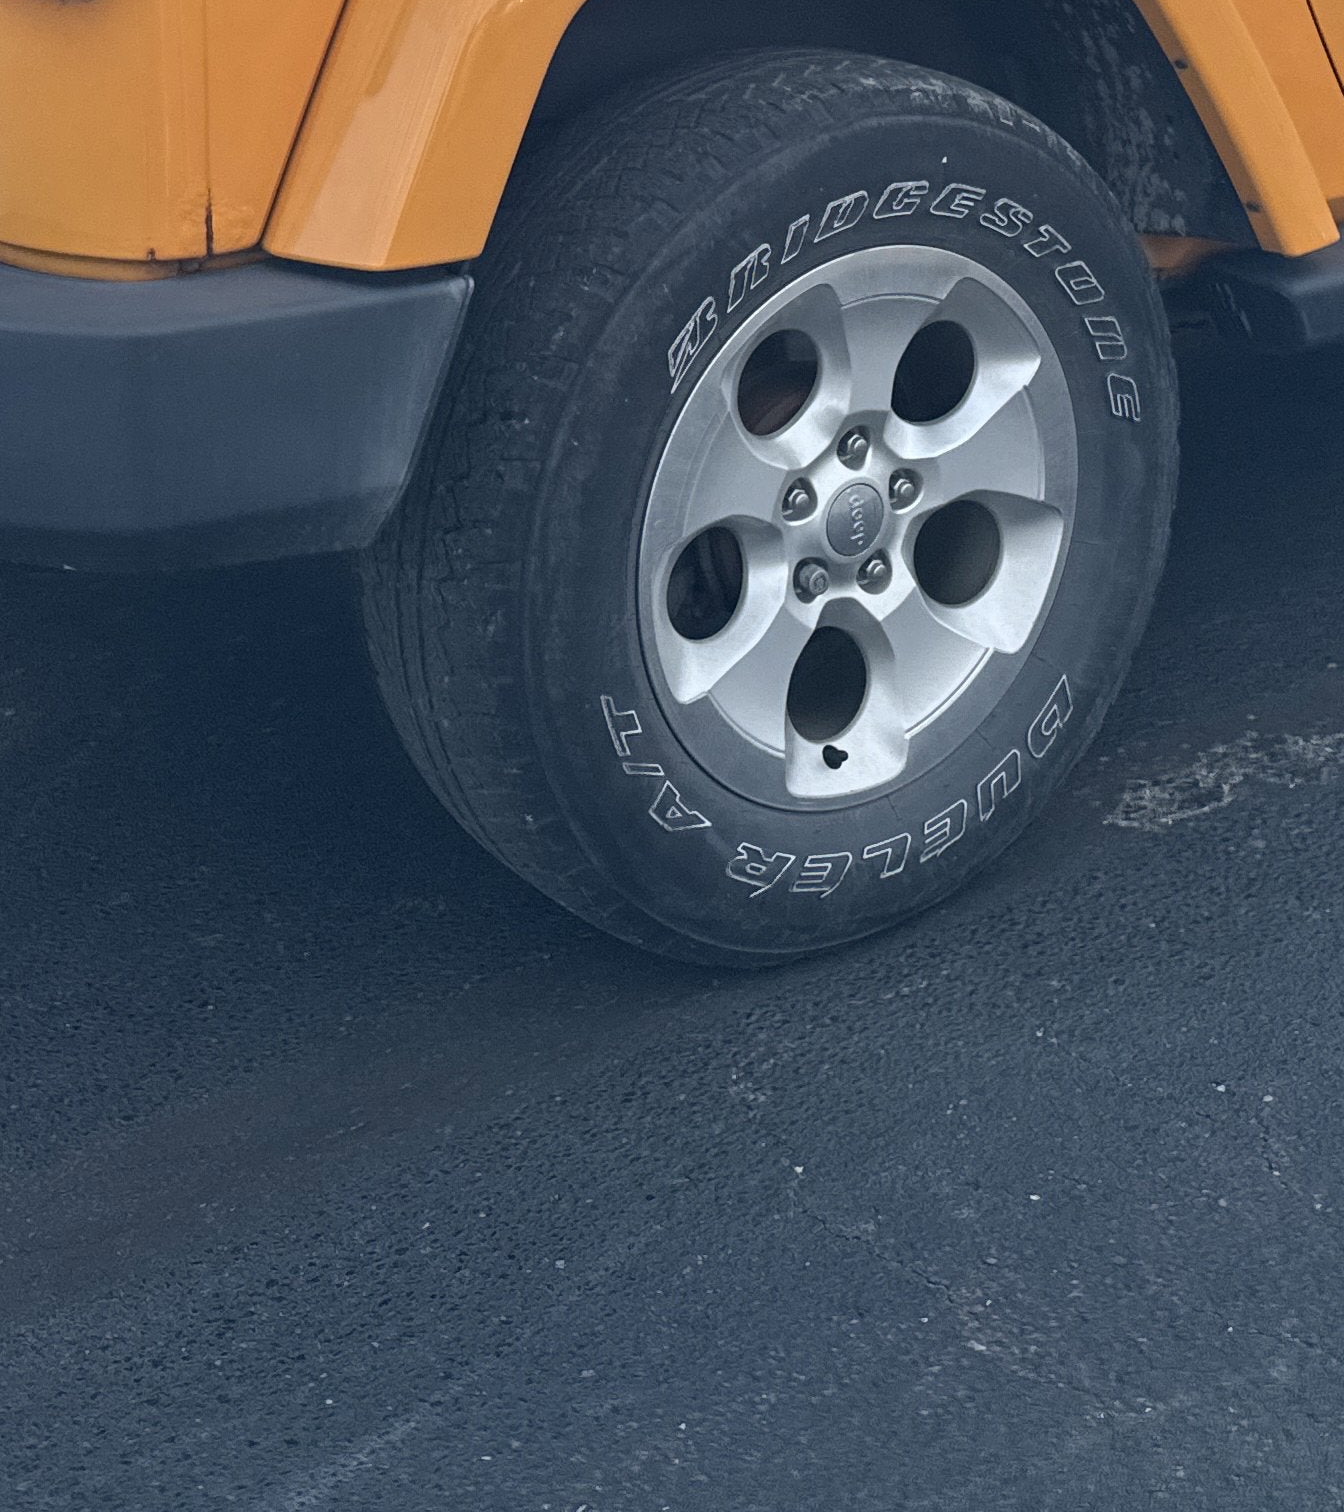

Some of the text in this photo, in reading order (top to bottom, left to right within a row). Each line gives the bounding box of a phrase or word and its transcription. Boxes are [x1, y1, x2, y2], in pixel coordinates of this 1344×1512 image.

[668, 180, 1141, 423] BRIDGESTONE
[600, 674, 1074, 898] DUELER A/T
